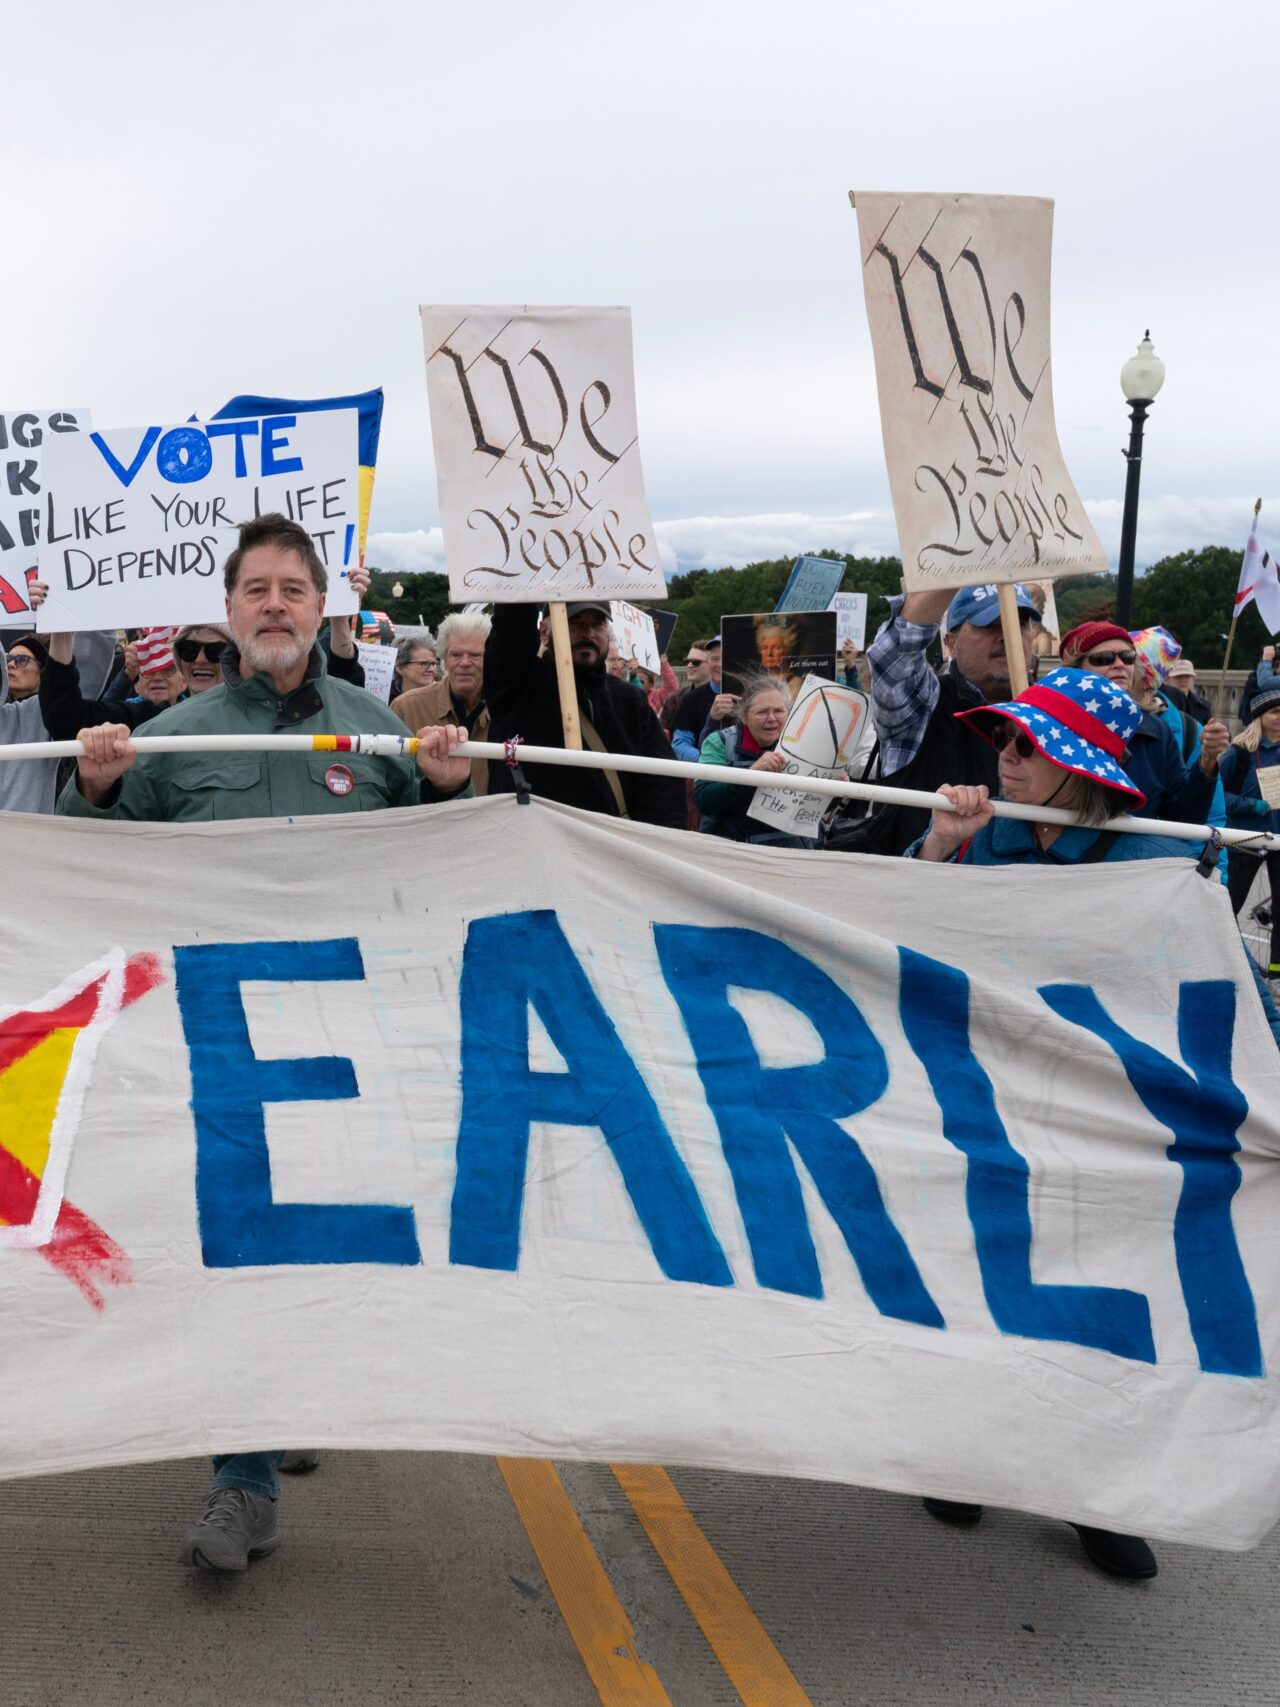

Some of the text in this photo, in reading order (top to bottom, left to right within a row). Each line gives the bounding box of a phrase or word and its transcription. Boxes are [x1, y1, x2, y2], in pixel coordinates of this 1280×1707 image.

[865, 204, 1049, 429] We
[427, 317, 638, 482] We
[958, 390, 1027, 478] the
[90, 416, 303, 487] VOTE
[519, 449, 601, 519] the
[47, 491, 126, 543] LIKE
[151, 493, 234, 532] YOUR
[464, 502, 656, 588] People
[914, 458, 1083, 571] People
[64, 536, 218, 590] DEPENDS
[789, 660, 800, 668] Let
[761, 792, 789, 813] THE
[173, 909, 1266, 1379] EARLY
